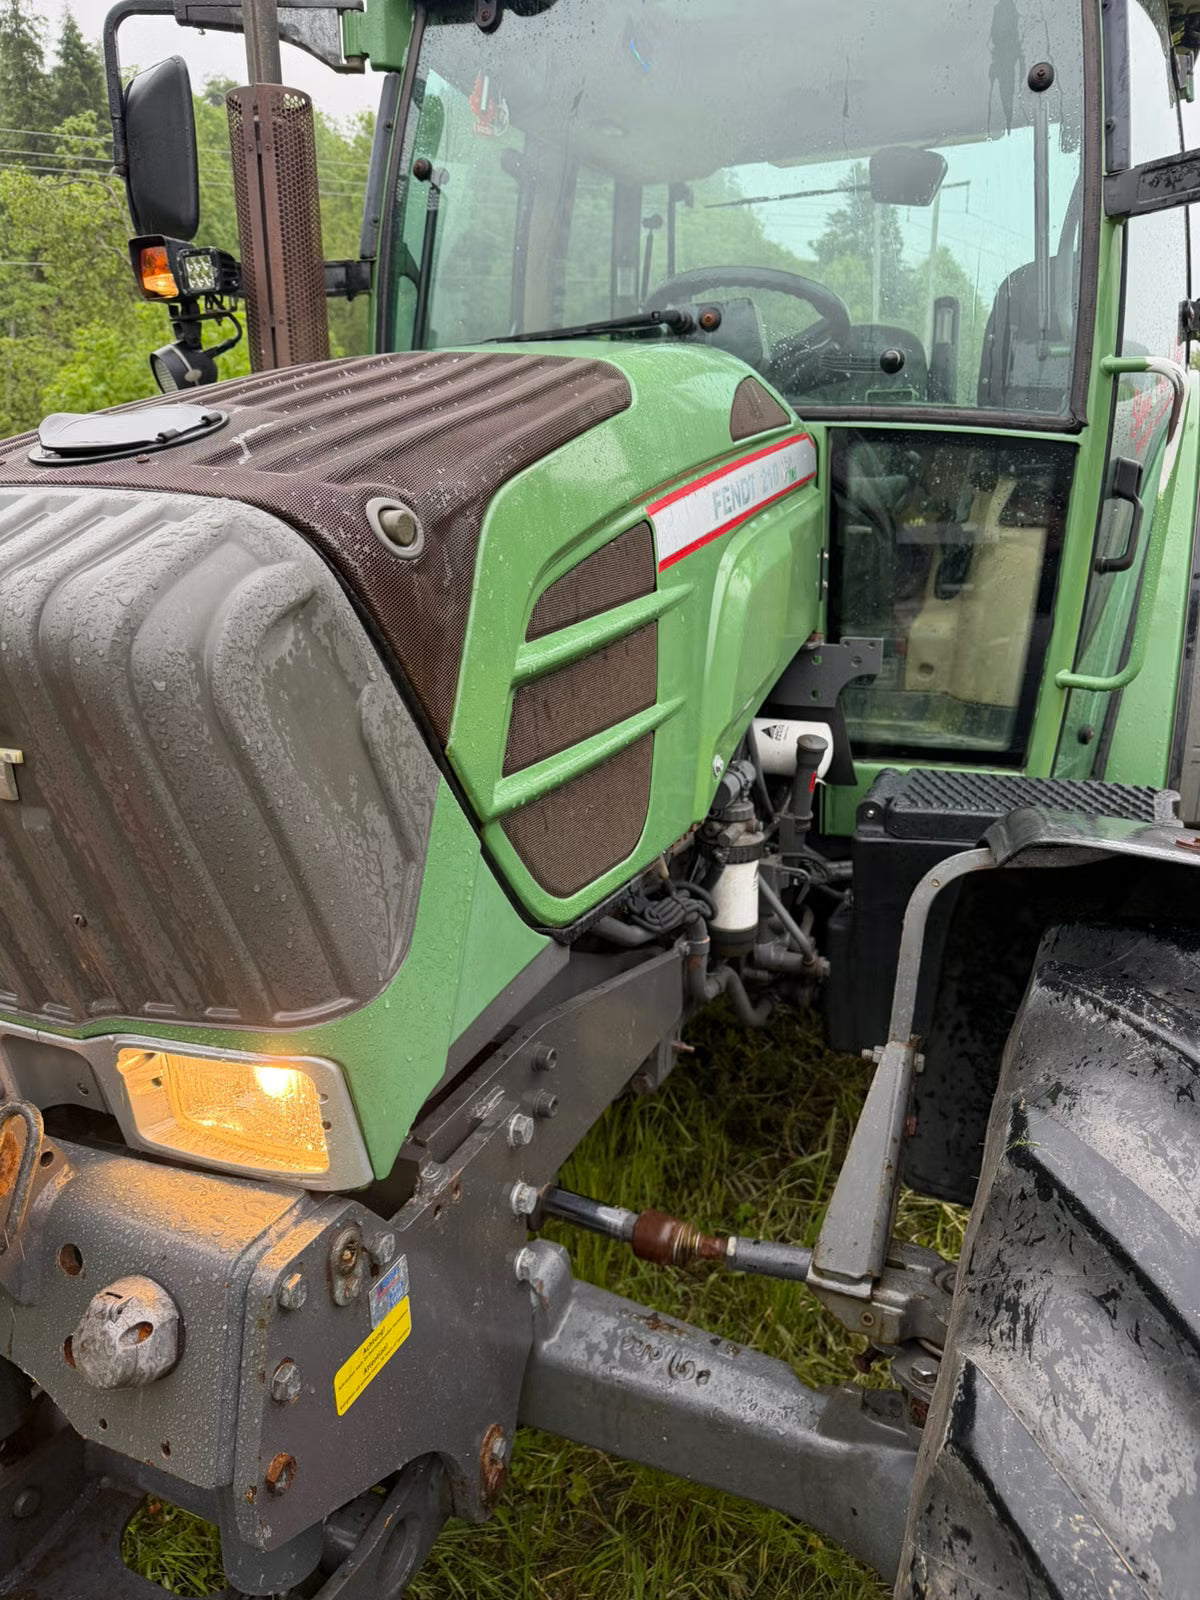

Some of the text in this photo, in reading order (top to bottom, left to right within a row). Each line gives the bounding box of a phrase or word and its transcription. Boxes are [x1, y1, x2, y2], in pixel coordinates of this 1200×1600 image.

[711, 474, 756, 521] FENDT
[760, 463, 780, 492] 210
[362, 1326, 386, 1354] Achtung!
